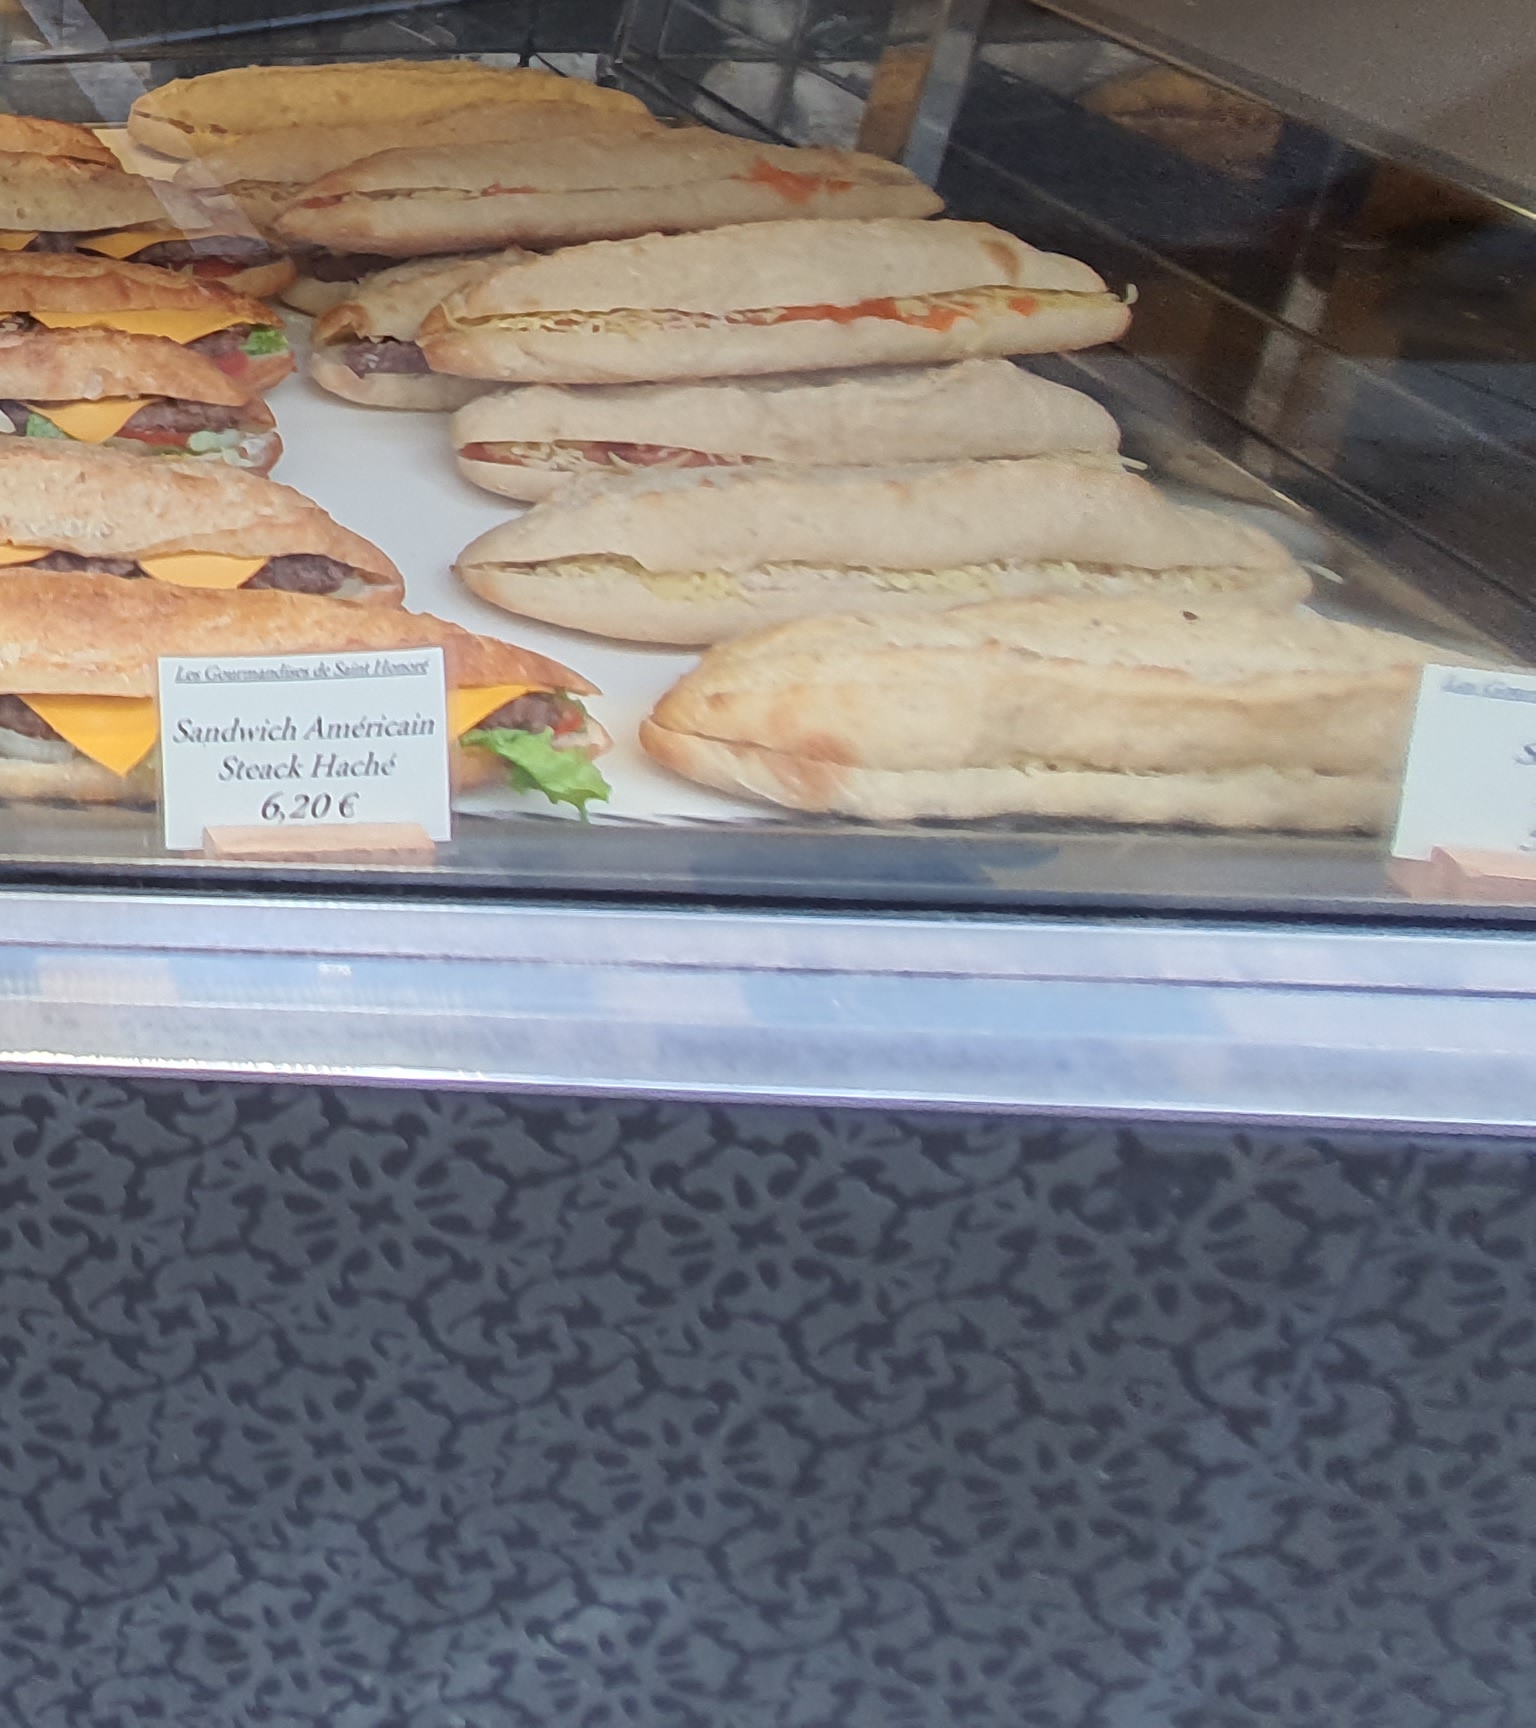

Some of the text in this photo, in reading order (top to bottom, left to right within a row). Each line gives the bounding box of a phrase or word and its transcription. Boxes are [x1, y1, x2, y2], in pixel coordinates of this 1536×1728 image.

[172, 713, 435, 744] Sandwich Américain
[218, 751, 398, 782] Steack Haché
[261, 791, 360, 823] 6,20 €
